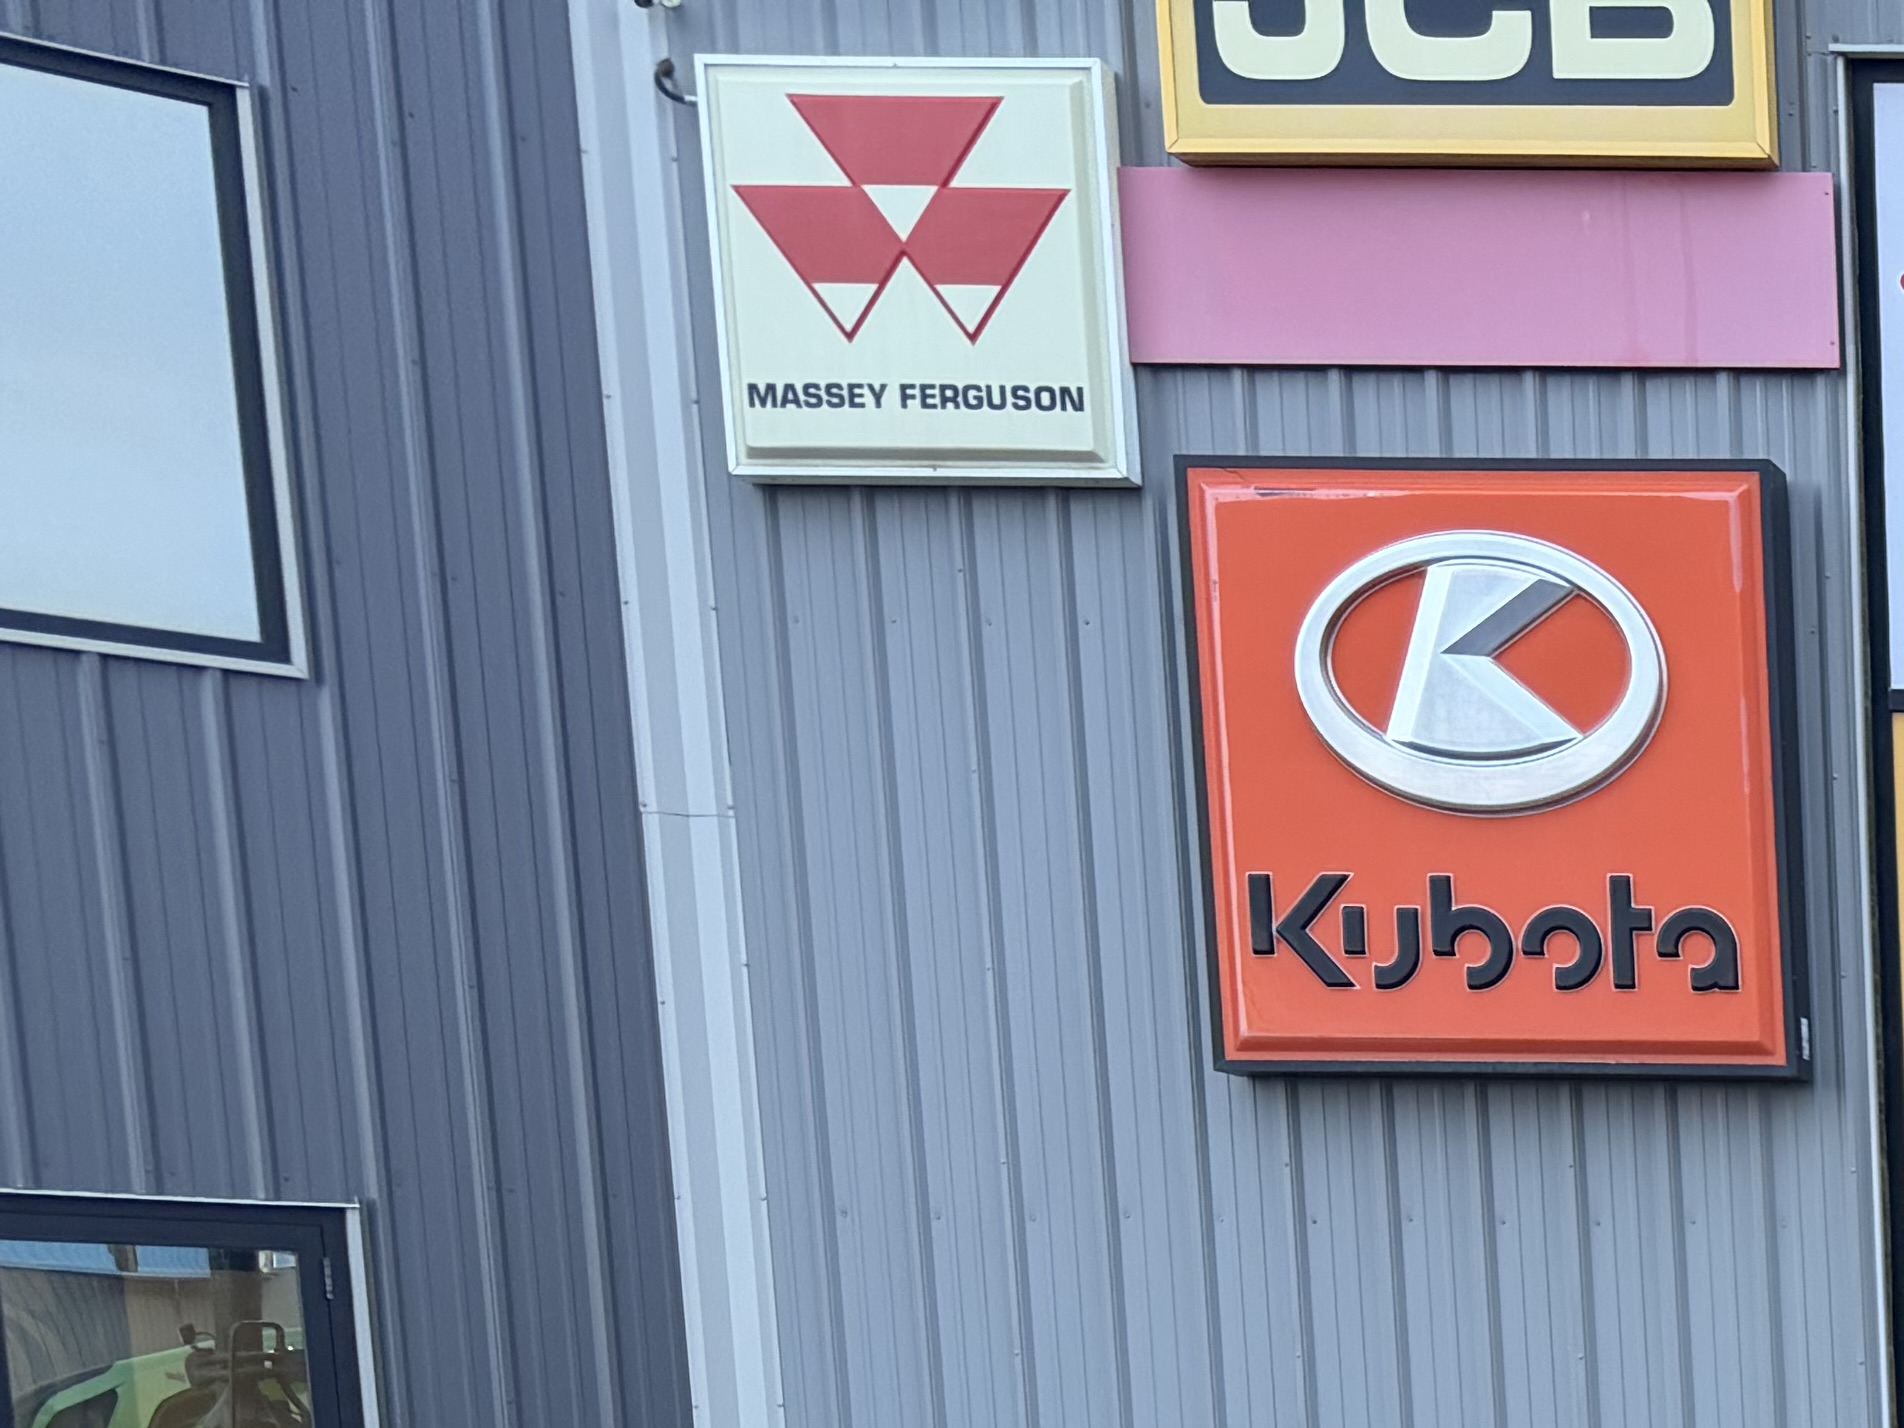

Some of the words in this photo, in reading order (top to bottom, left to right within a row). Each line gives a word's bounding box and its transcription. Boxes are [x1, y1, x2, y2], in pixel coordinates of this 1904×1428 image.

[747, 382, 888, 410] MASSEY
[899, 383, 1085, 412] FERGUSON
[1246, 871, 1741, 993] Kubota
